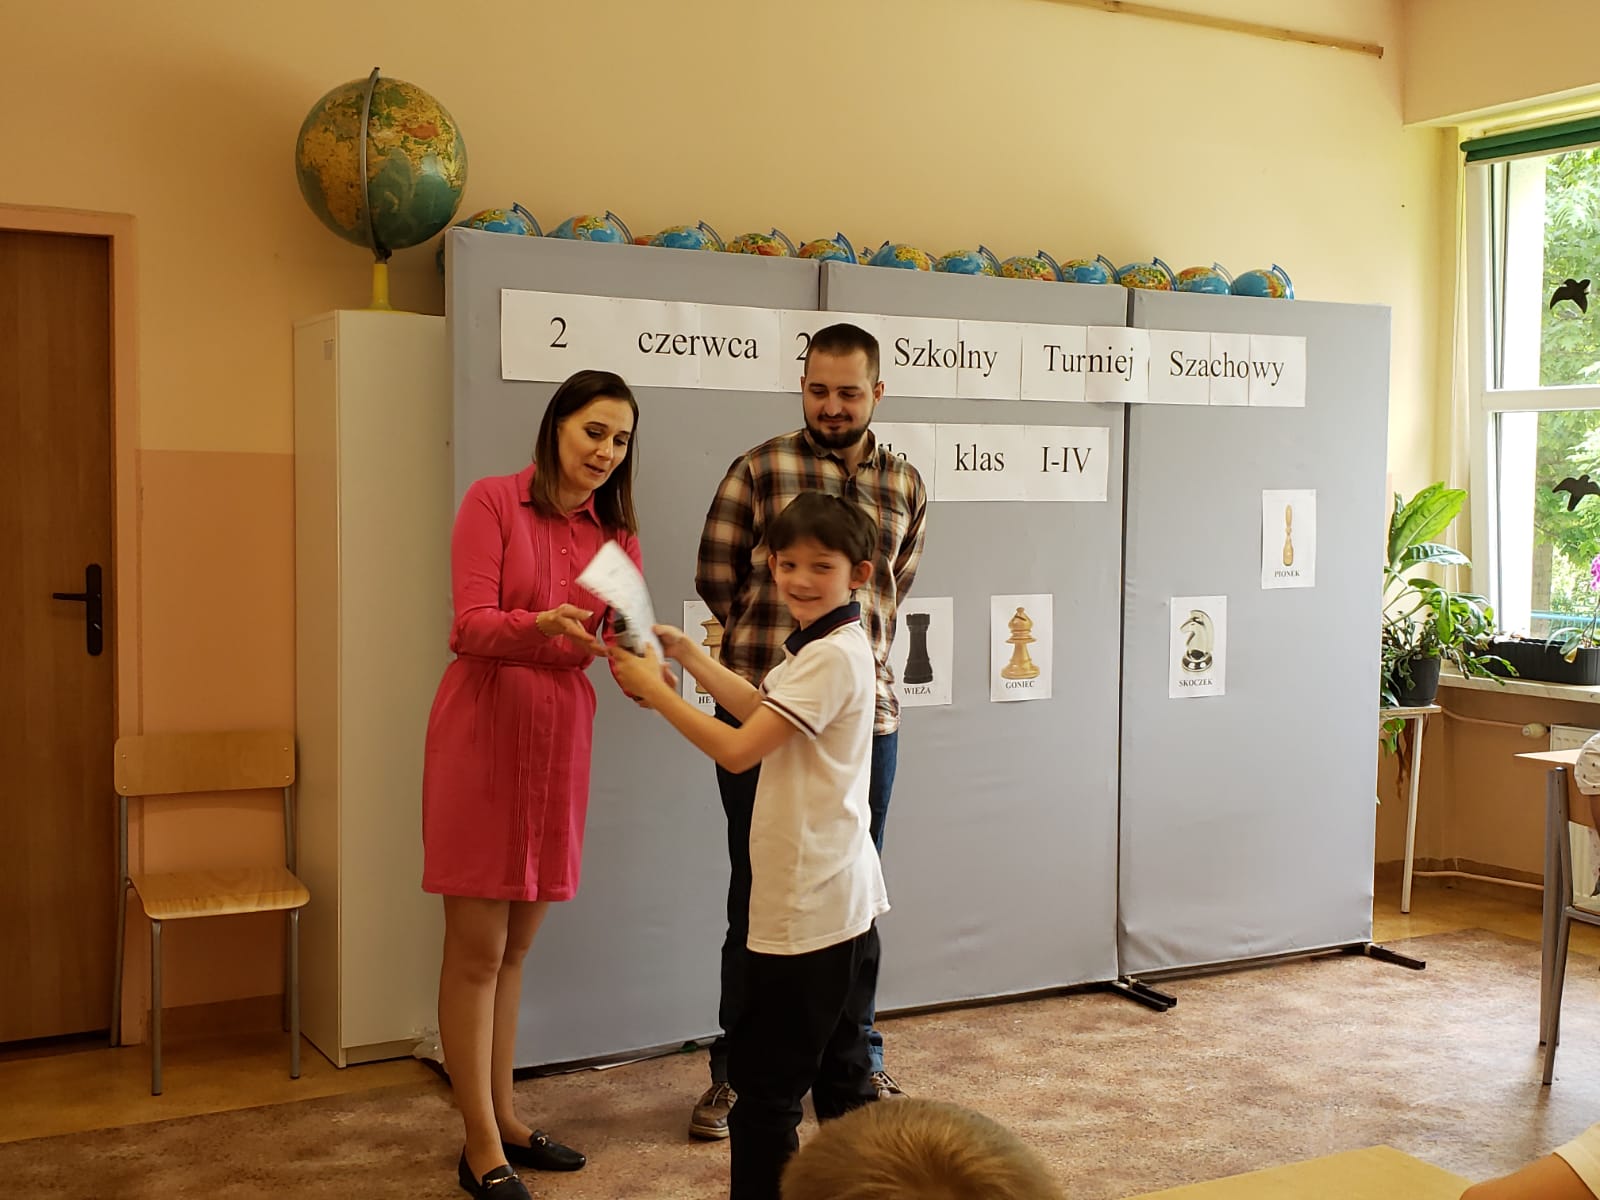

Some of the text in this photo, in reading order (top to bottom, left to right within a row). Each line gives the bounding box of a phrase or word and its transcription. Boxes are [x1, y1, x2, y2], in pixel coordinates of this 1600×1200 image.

[549, 316, 569, 349] 2
[638, 331, 760, 360] czerwca
[893, 337, 999, 378] Szkolny
[1043, 344, 1134, 382] Turniej
[1169, 350, 1285, 387] Szachowy
[954, 443, 1093, 474] klas I-IV
[1273, 569, 1301, 578] PIONEK
[1004, 680, 1036, 689] GONIEC
[1178, 678, 1213, 687] SKOCZEK
